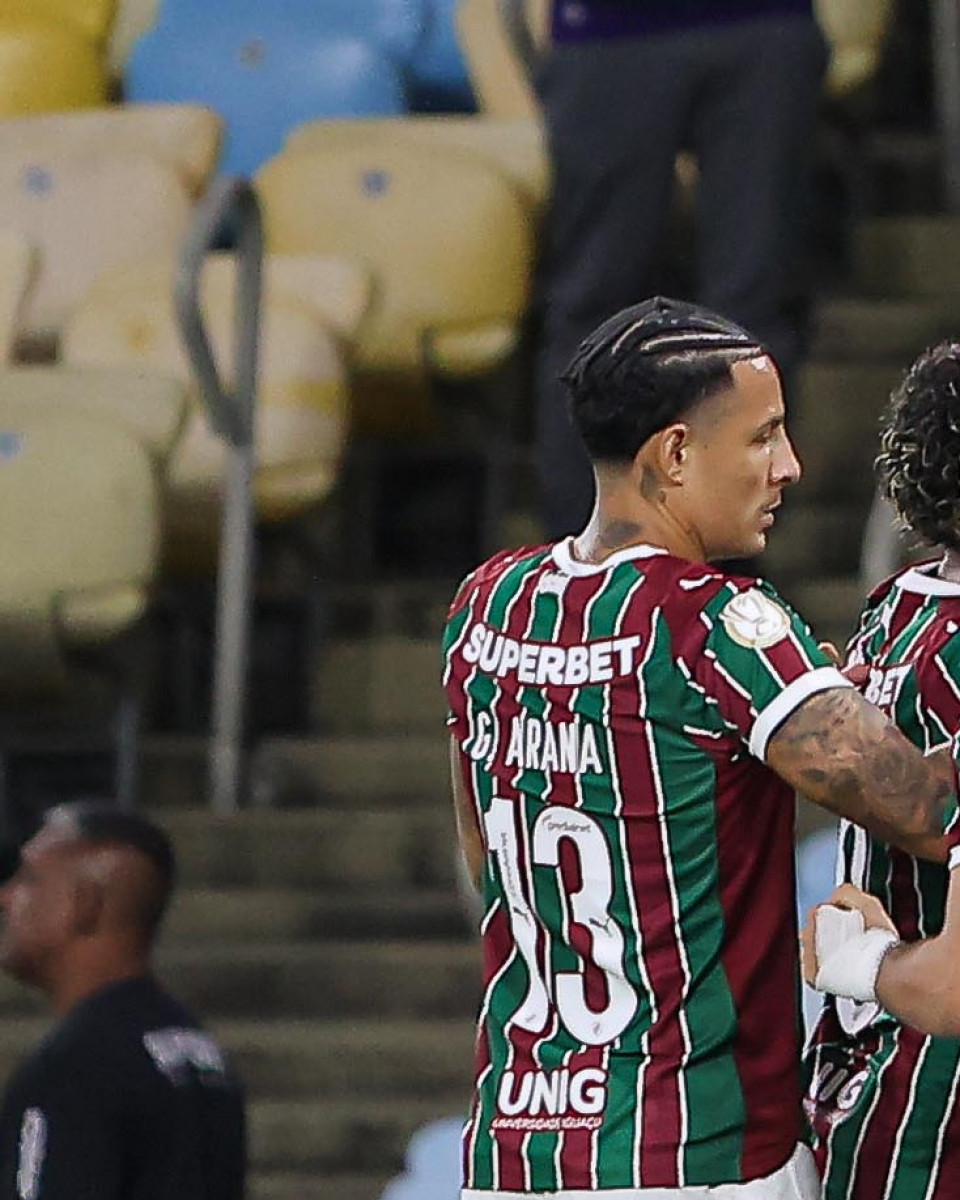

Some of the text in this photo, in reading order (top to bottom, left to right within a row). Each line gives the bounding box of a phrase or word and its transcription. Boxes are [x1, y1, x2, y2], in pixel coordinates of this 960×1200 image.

[461, 622, 641, 686] SUPERBET
[505, 715, 603, 774] ARANA
[484, 797, 639, 1046] 13
[498, 1067, 608, 1116] UNIG
